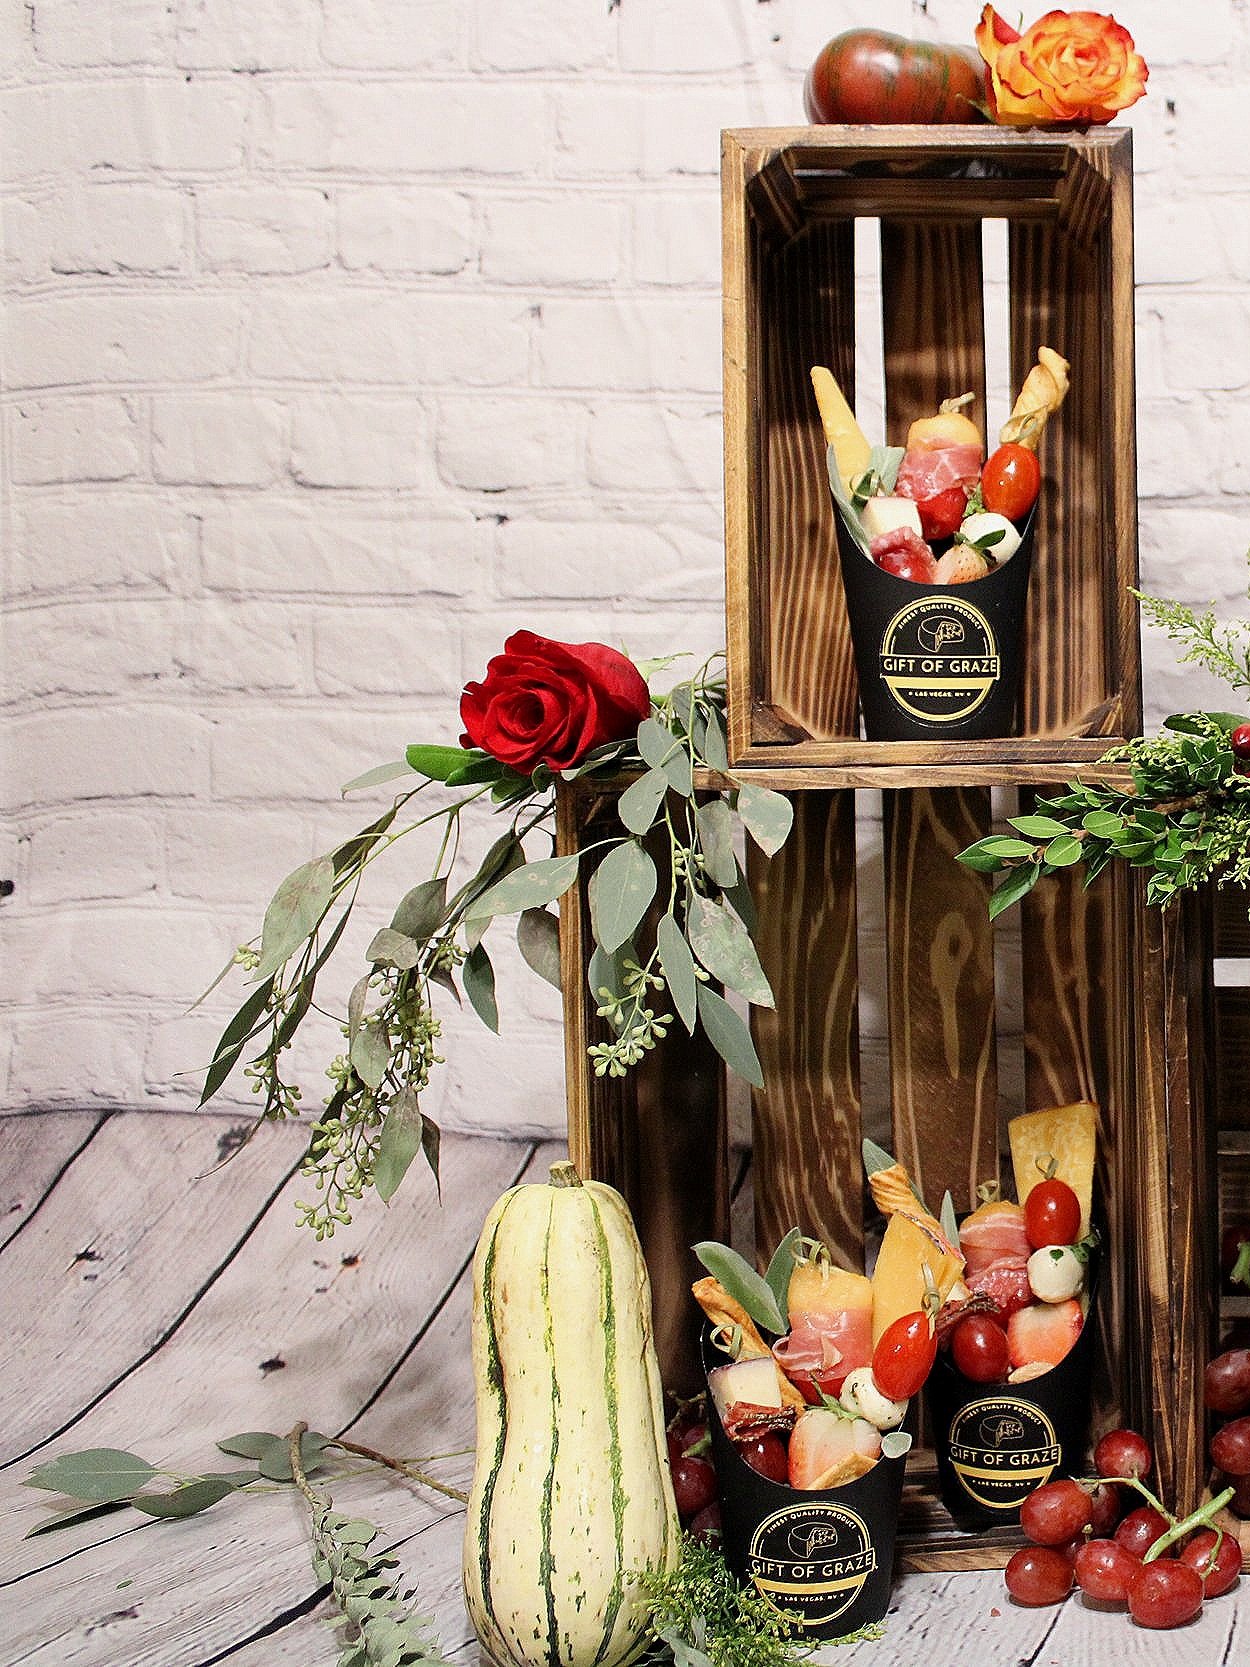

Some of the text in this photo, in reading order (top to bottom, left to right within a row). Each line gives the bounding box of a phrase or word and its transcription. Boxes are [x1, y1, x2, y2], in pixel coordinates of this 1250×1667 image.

[884, 658, 996, 673] GIFT OF GRAZE
[951, 1447, 1058, 1465] GIFT OF GRAZE
[752, 1553, 872, 1578] GIFT OF GRAZE
